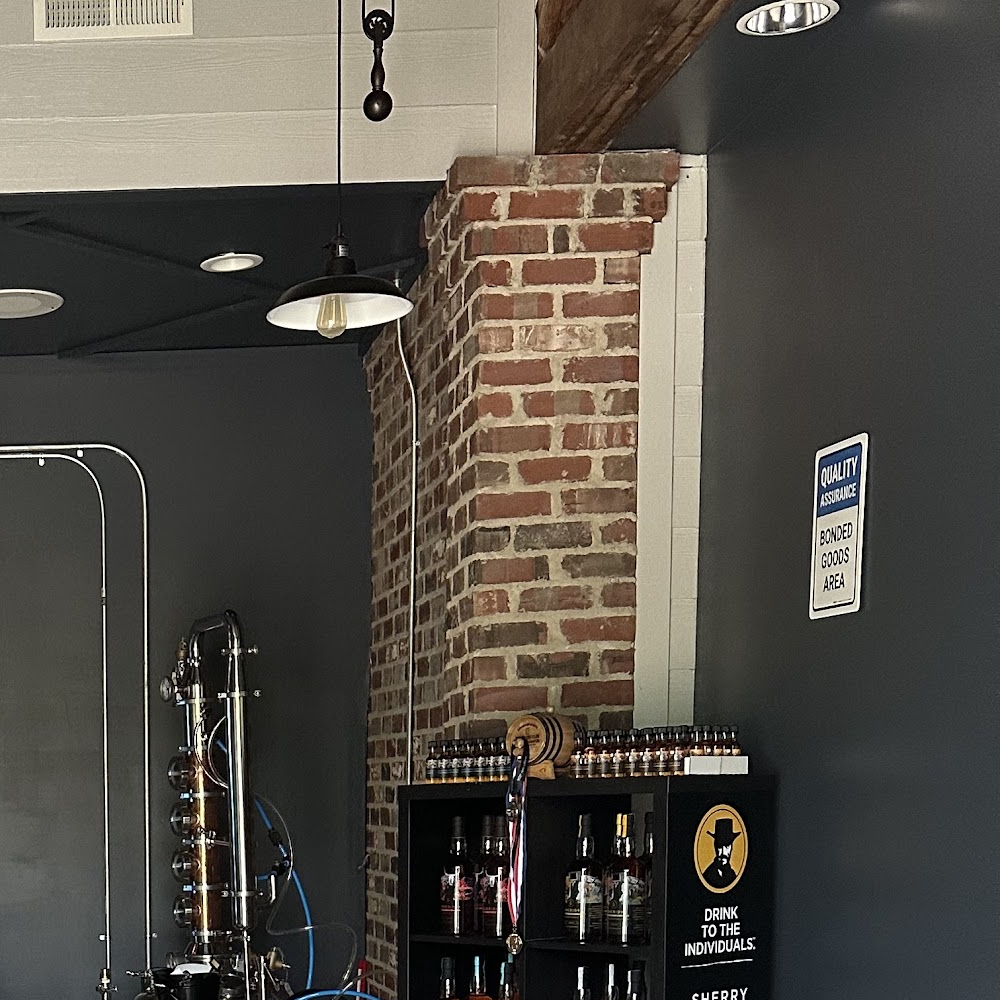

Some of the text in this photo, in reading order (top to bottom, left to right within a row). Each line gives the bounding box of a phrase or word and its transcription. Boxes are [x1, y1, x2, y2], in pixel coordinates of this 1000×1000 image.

[821, 455, 858, 488] QUALITY
[820, 482, 857, 508] ASSURANCE
[820, 522, 853, 546] BONDED
[822, 547, 849, 568] GOODS
[823, 572, 845, 592] AREA
[704, 905, 738, 921] DRINK
[701, 922, 741, 938] TO THE
